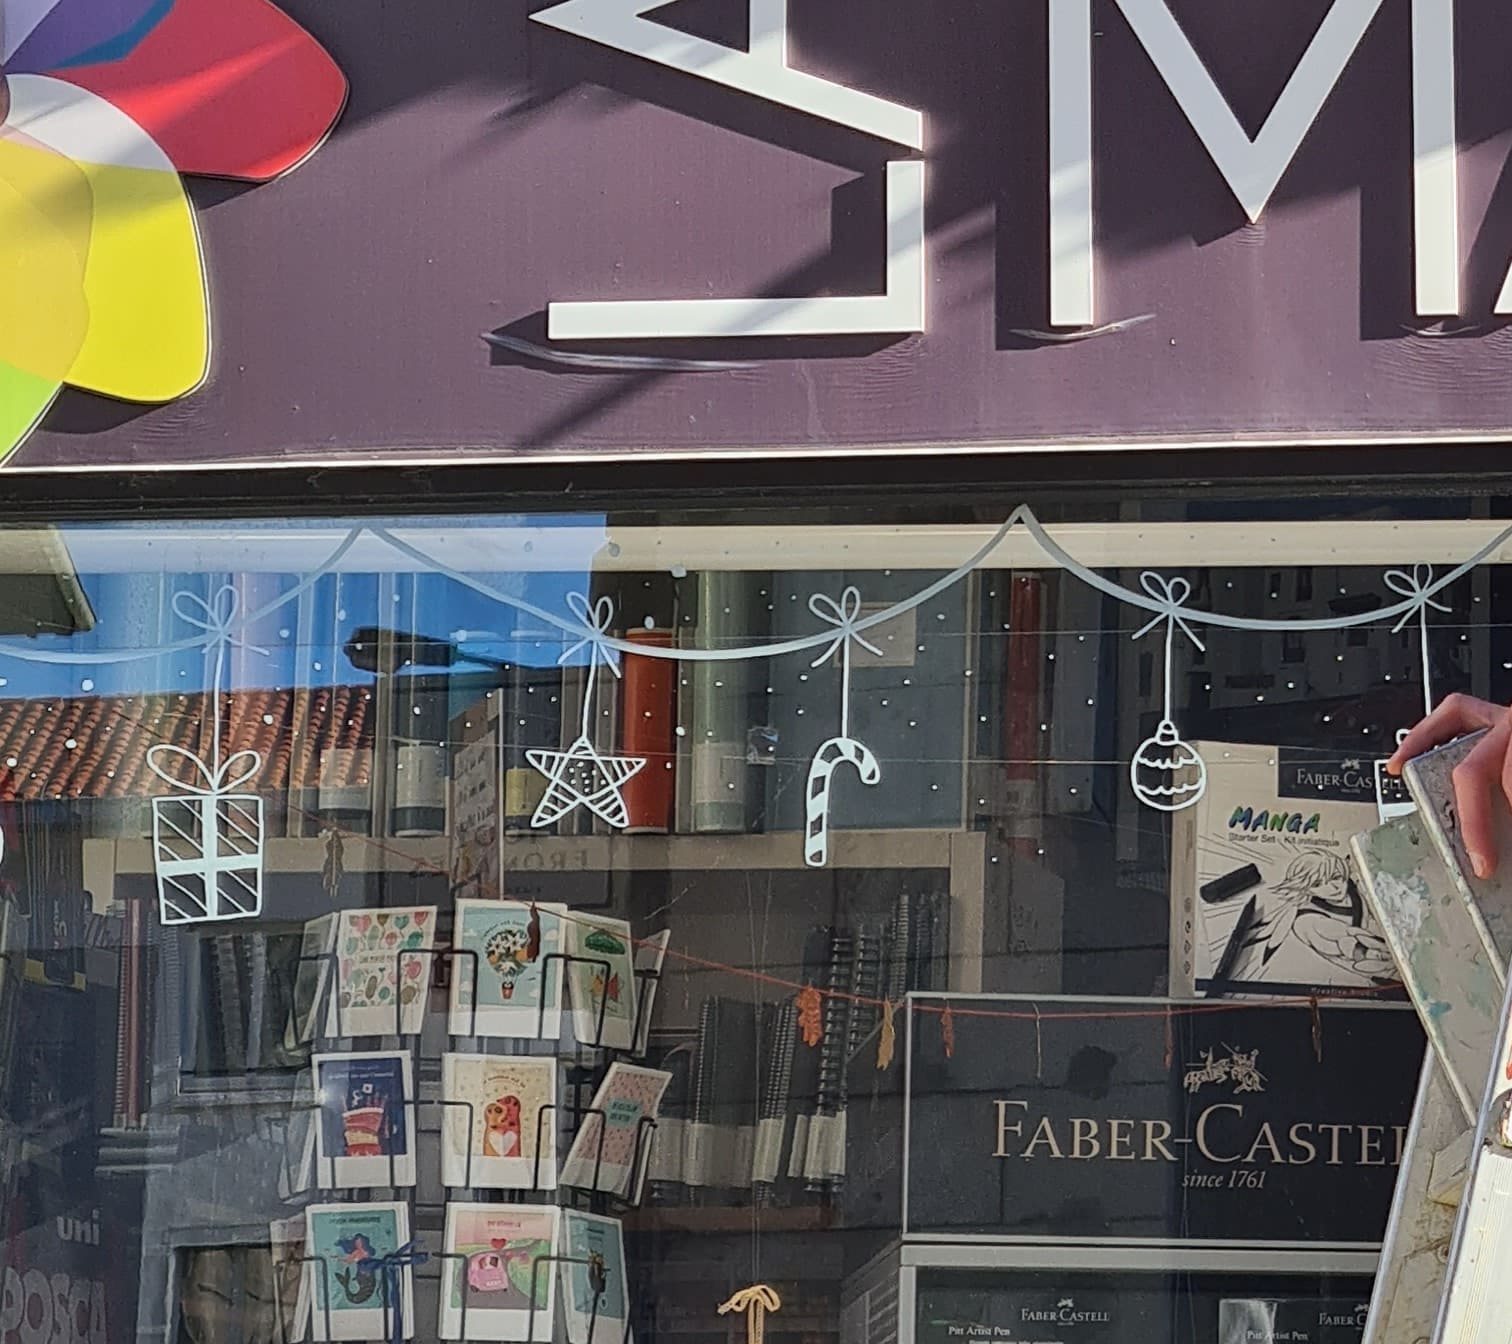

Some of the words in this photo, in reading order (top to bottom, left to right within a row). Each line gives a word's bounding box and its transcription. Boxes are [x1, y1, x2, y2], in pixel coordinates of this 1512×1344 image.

[1228, 806, 1322, 834] MANGA
[1228, 833, 1260, 844] Starter
[1261, 834, 1276, 844] Set
[991, 1099, 1408, 1166] FABER-CASTEL
[1182, 1167, 1224, 1189] since
[1228, 1169, 1265, 1189] 1761
[56, 1208, 101, 1247] uni
[1021, 1307, 1111, 1322] FABER-CASTELL
[966, 1326, 991, 1336] Artist
[994, 1327, 1010, 1336] Pen
